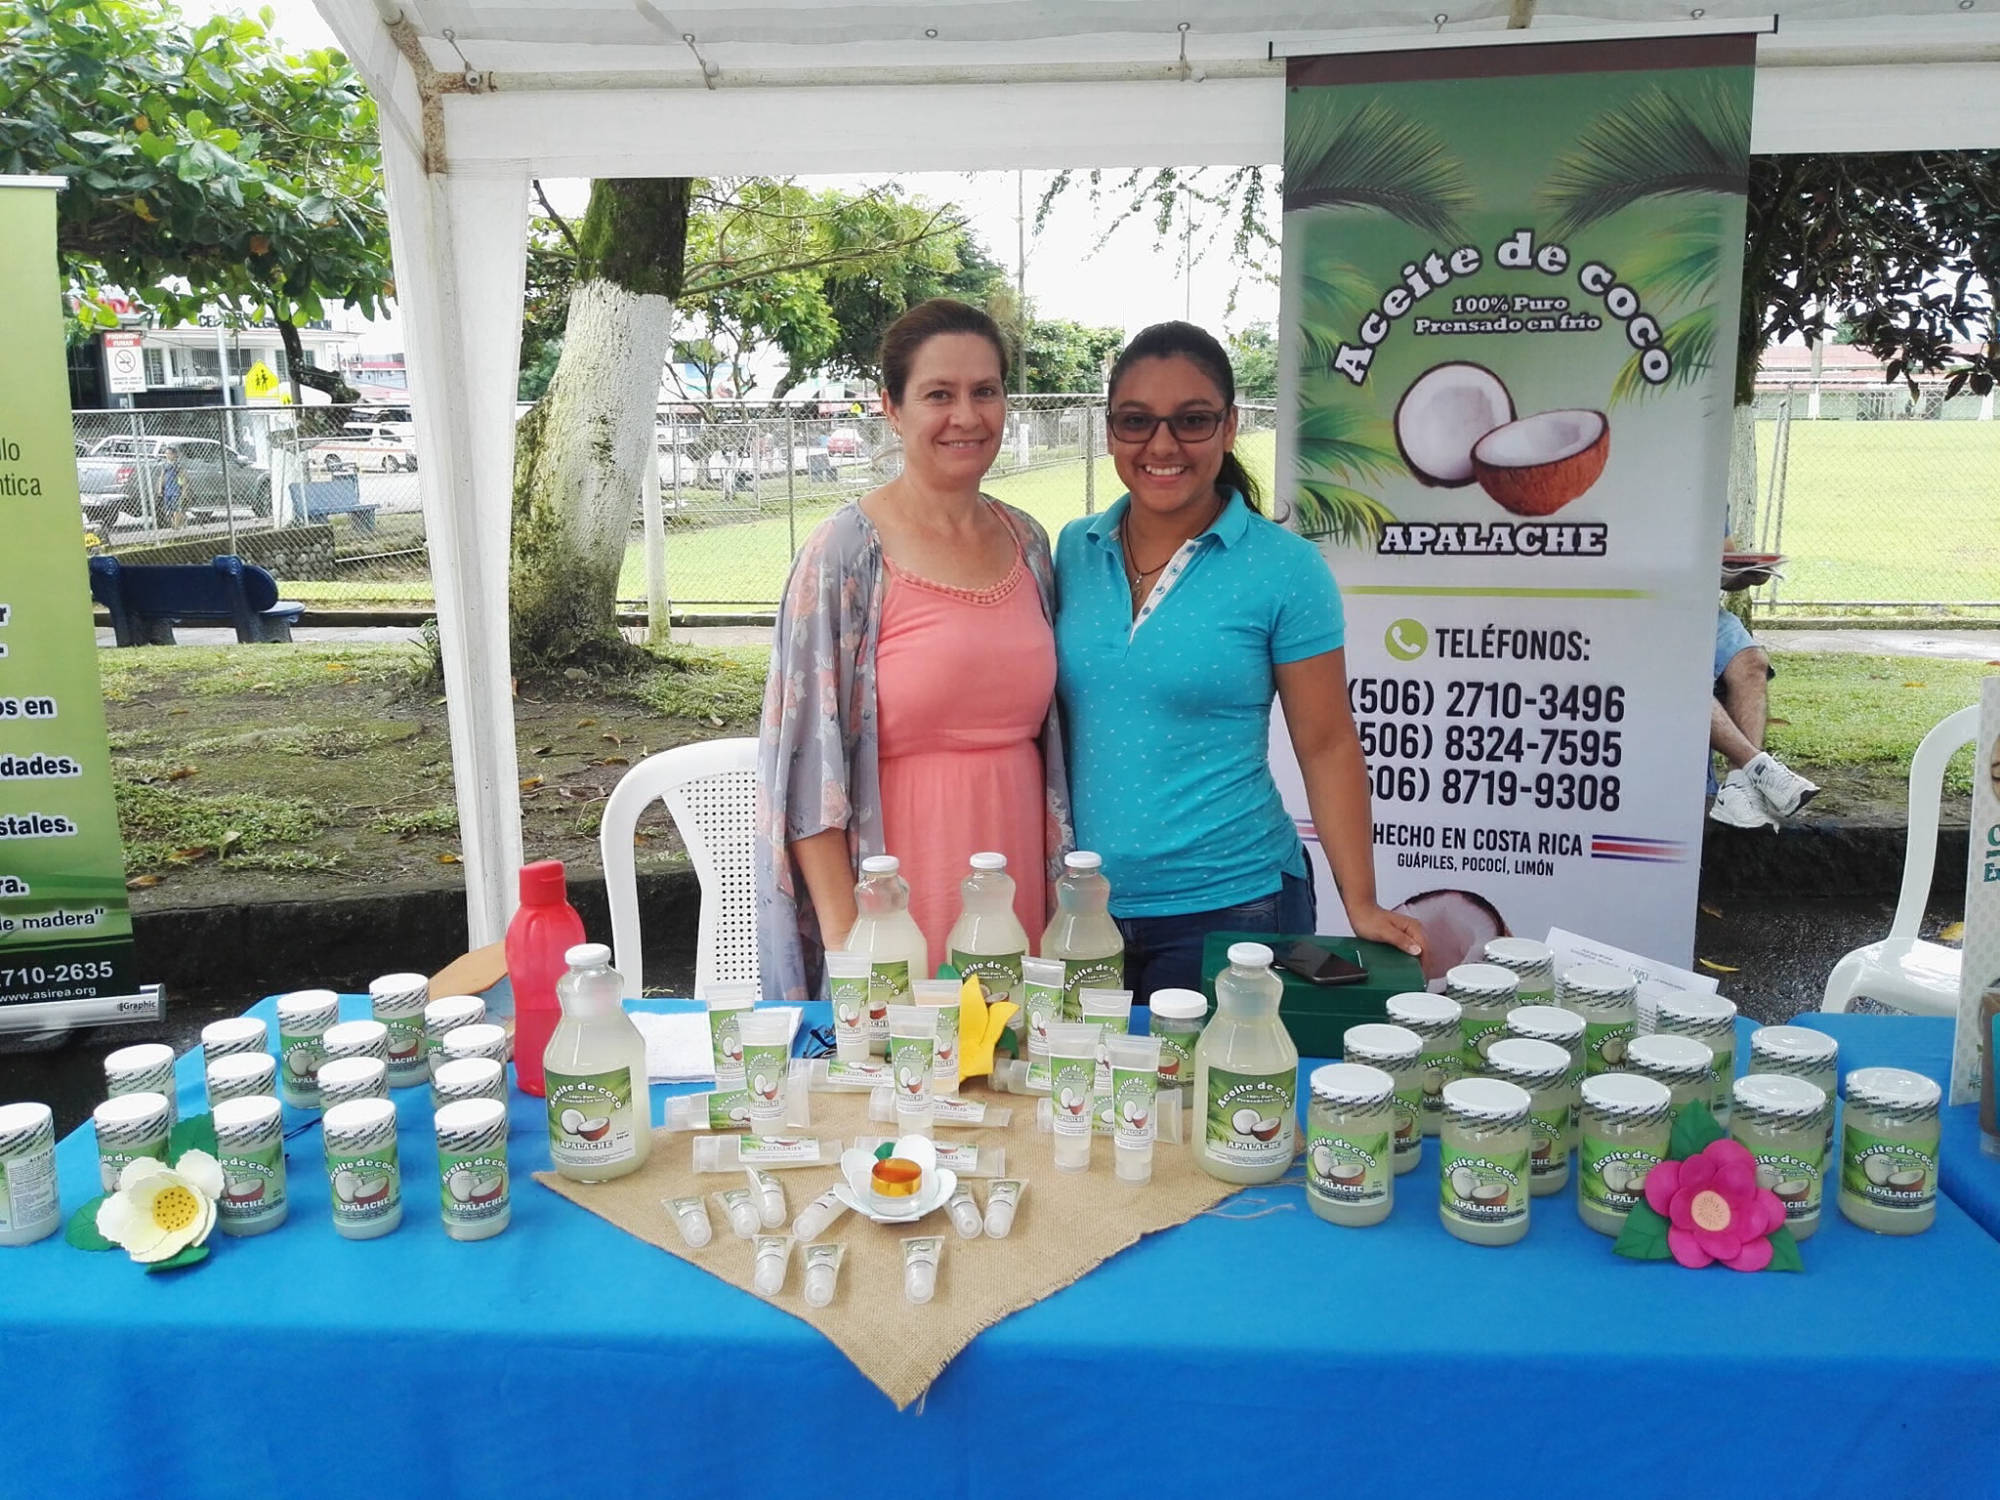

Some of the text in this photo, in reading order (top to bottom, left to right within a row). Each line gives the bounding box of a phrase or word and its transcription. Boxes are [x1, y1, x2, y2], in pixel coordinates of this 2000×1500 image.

[1335, 232, 1670, 383] Aceite de coco
[1453, 297, 1568, 313] 100% Puro
[1415, 318, 1525, 334] Prensado
[1527, 319, 1558, 332] en
[0, 438, 20, 462] lo
[1379, 522, 1608, 556] APALACHE
[1436, 624, 1591, 661] TELÉFONOS:
[25, 700, 53, 715] en
[1348, 678, 1625, 723] (506) 2710-3496
[1357, 722, 1622, 767] 506) 8324-7595
[1442, 768, 1621, 812] 8719-9308
[1372, 823, 1583, 856] HECHO EN COSTA RICA
[1397, 851, 1554, 877] GUÁPILES, POCOCÍ, LIMÓN
[23, 908, 104, 929] madera"
[0, 961, 113, 988] 710-2635
[961, 961, 984, 978] ceite
[986, 960, 1001, 969] de
[1064, 966, 1093, 991] Aceite
[577, 1082, 595, 1091] de
[598, 1087, 622, 1109] coco
[1217, 1084, 1254, 1109] Aceite
[1257, 1082, 1274, 1090] de
[356, 1158, 374, 1166] de
[1334, 1138, 1351, 1149] de
[1352, 1147, 1376, 1167] coco
[1593, 1151, 1630, 1172] Aceite
[1632, 1151, 1649, 1160] de
[1780, 1155, 1798, 1165] de
[1854, 1144, 1893, 1164] Aceite
[1895, 1145, 1913, 1155] de
[230, 1157, 274, 1177] de coco
[442, 1161, 472, 1184] Aceite
[474, 1157, 491, 1166] de
[1476, 1158, 1494, 1169] de
[1495, 1166, 1519, 1185] coco
[1313, 1176, 1364, 1192] APALACHE
[1865, 1185, 1924, 1199] APALACHE
[340, 1197, 391, 1211] APALACHE
[453, 1196, 504, 1211] APALACHE
[1454, 1199, 1508, 1213] APALACHE
